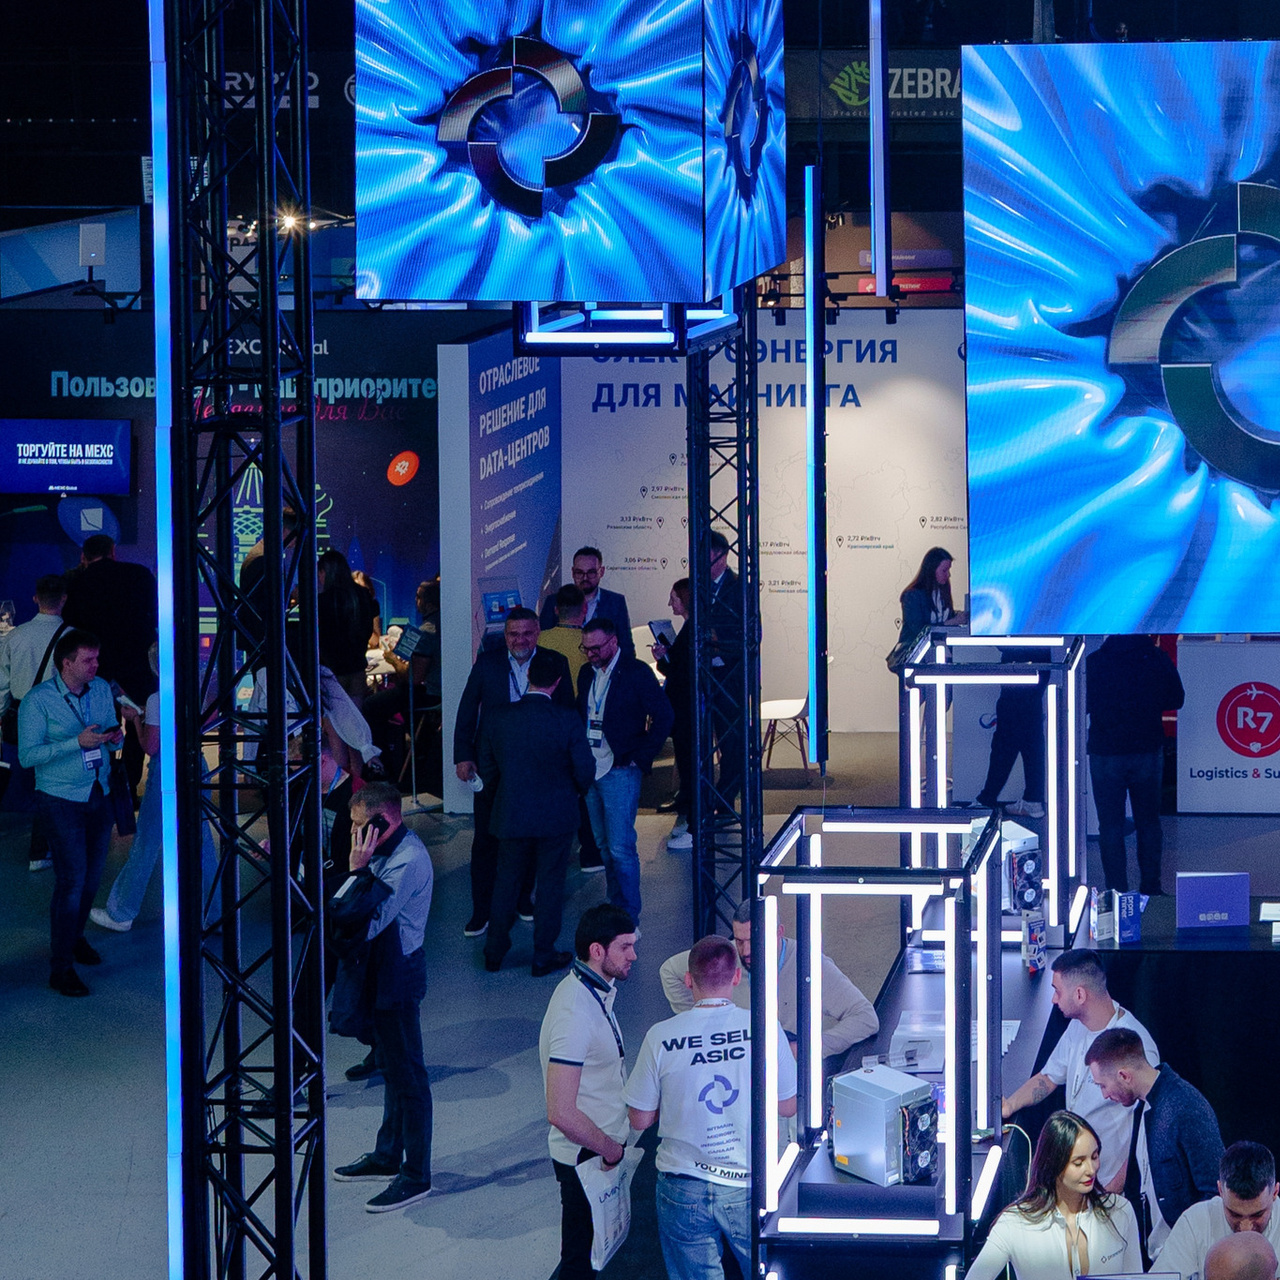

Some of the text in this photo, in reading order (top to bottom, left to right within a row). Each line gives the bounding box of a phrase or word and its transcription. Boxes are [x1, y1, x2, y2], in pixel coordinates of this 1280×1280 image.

[313, 377, 437, 404] приорите
[591, 384, 661, 413] ДЛЯ
[479, 387, 547, 438] РЕШЕНИЕ ДЛЯ
[17, 442, 67, 458] ТОРГУЙТЕ
[69, 444, 83, 458] НА
[1237, 707, 1274, 733] R7
[1190, 767, 1248, 781] Logistics
[1252, 768, 1260, 779] &
[662, 1029, 751, 1052] WE SEL
[690, 1047, 745, 1066] ASIC
[694, 1161, 717, 1173] YOU
[719, 1170, 751, 1179] MINE
